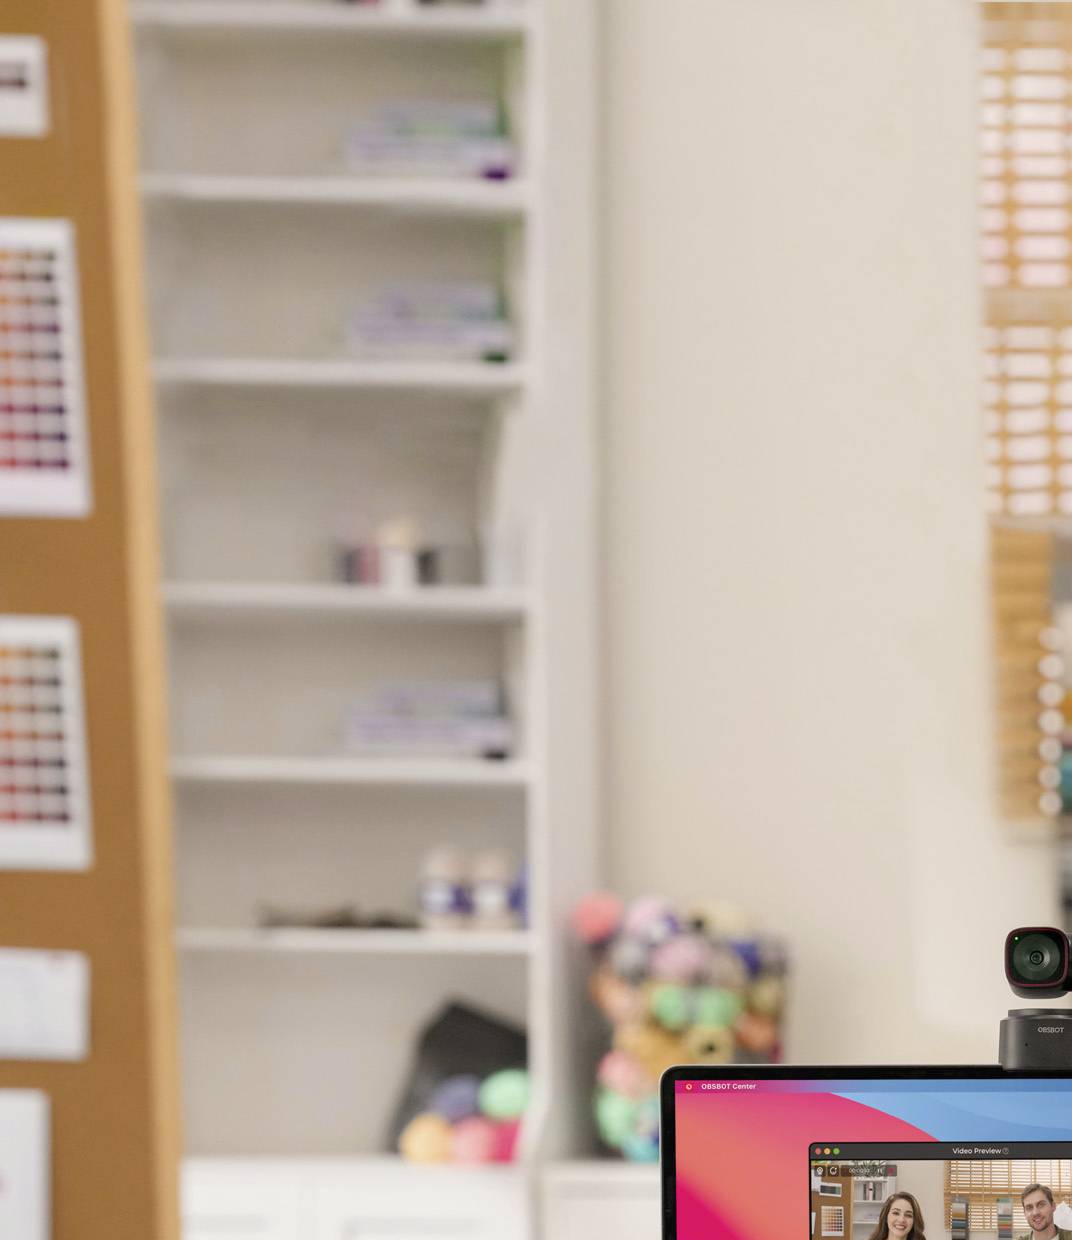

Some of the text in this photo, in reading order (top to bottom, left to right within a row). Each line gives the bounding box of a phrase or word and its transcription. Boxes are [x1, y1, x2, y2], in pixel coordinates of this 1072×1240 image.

[1037, 1026, 1065, 1034] OBSBOT
[952, 1146, 1002, 1154] Video Preview
